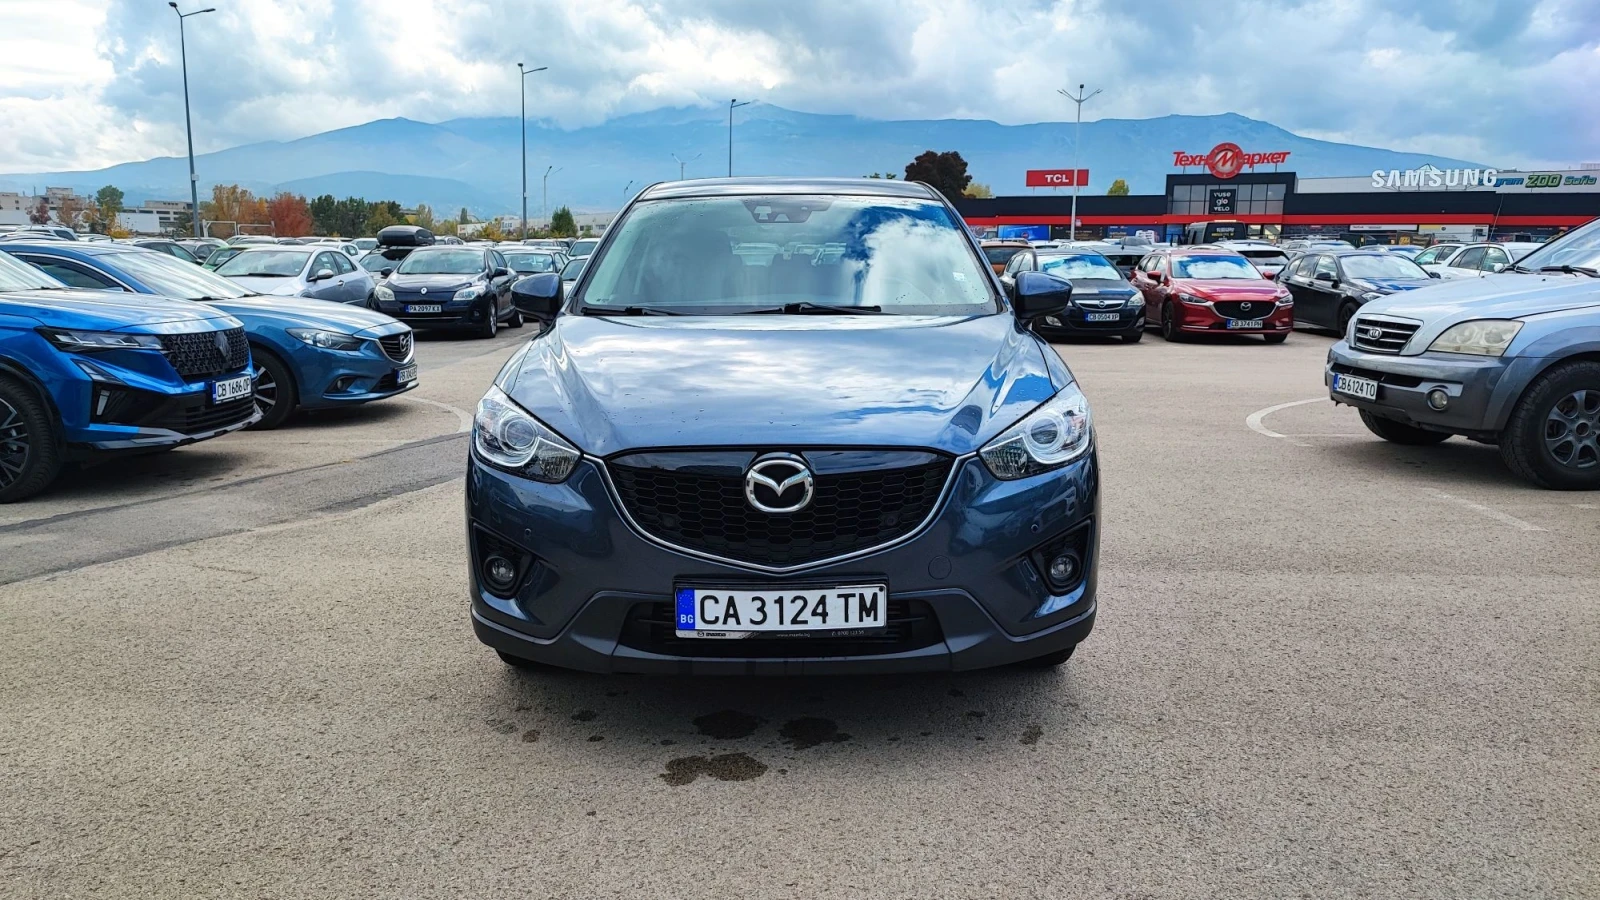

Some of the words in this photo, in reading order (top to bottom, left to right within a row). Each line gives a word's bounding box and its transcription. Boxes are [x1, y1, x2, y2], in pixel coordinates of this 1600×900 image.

[1044, 174, 1070, 183] TCL
[1371, 168, 1498, 188] SAMSUNG
[1525, 173, 1563, 188] ZOO
[1563, 175, 1598, 186] Sofia
[1215, 198, 1229, 206] glo
[217, 383, 227, 398] CB
[228, 380, 242, 396] 1686
[1338, 376, 1346, 390] CB
[1347, 379, 1364, 395] 6124
[1365, 382, 1376, 397] TO
[700, 594, 742, 625] CA
[749, 594, 828, 625] 3124
[837, 592, 878, 623] TM
[680, 614, 694, 624] BG
